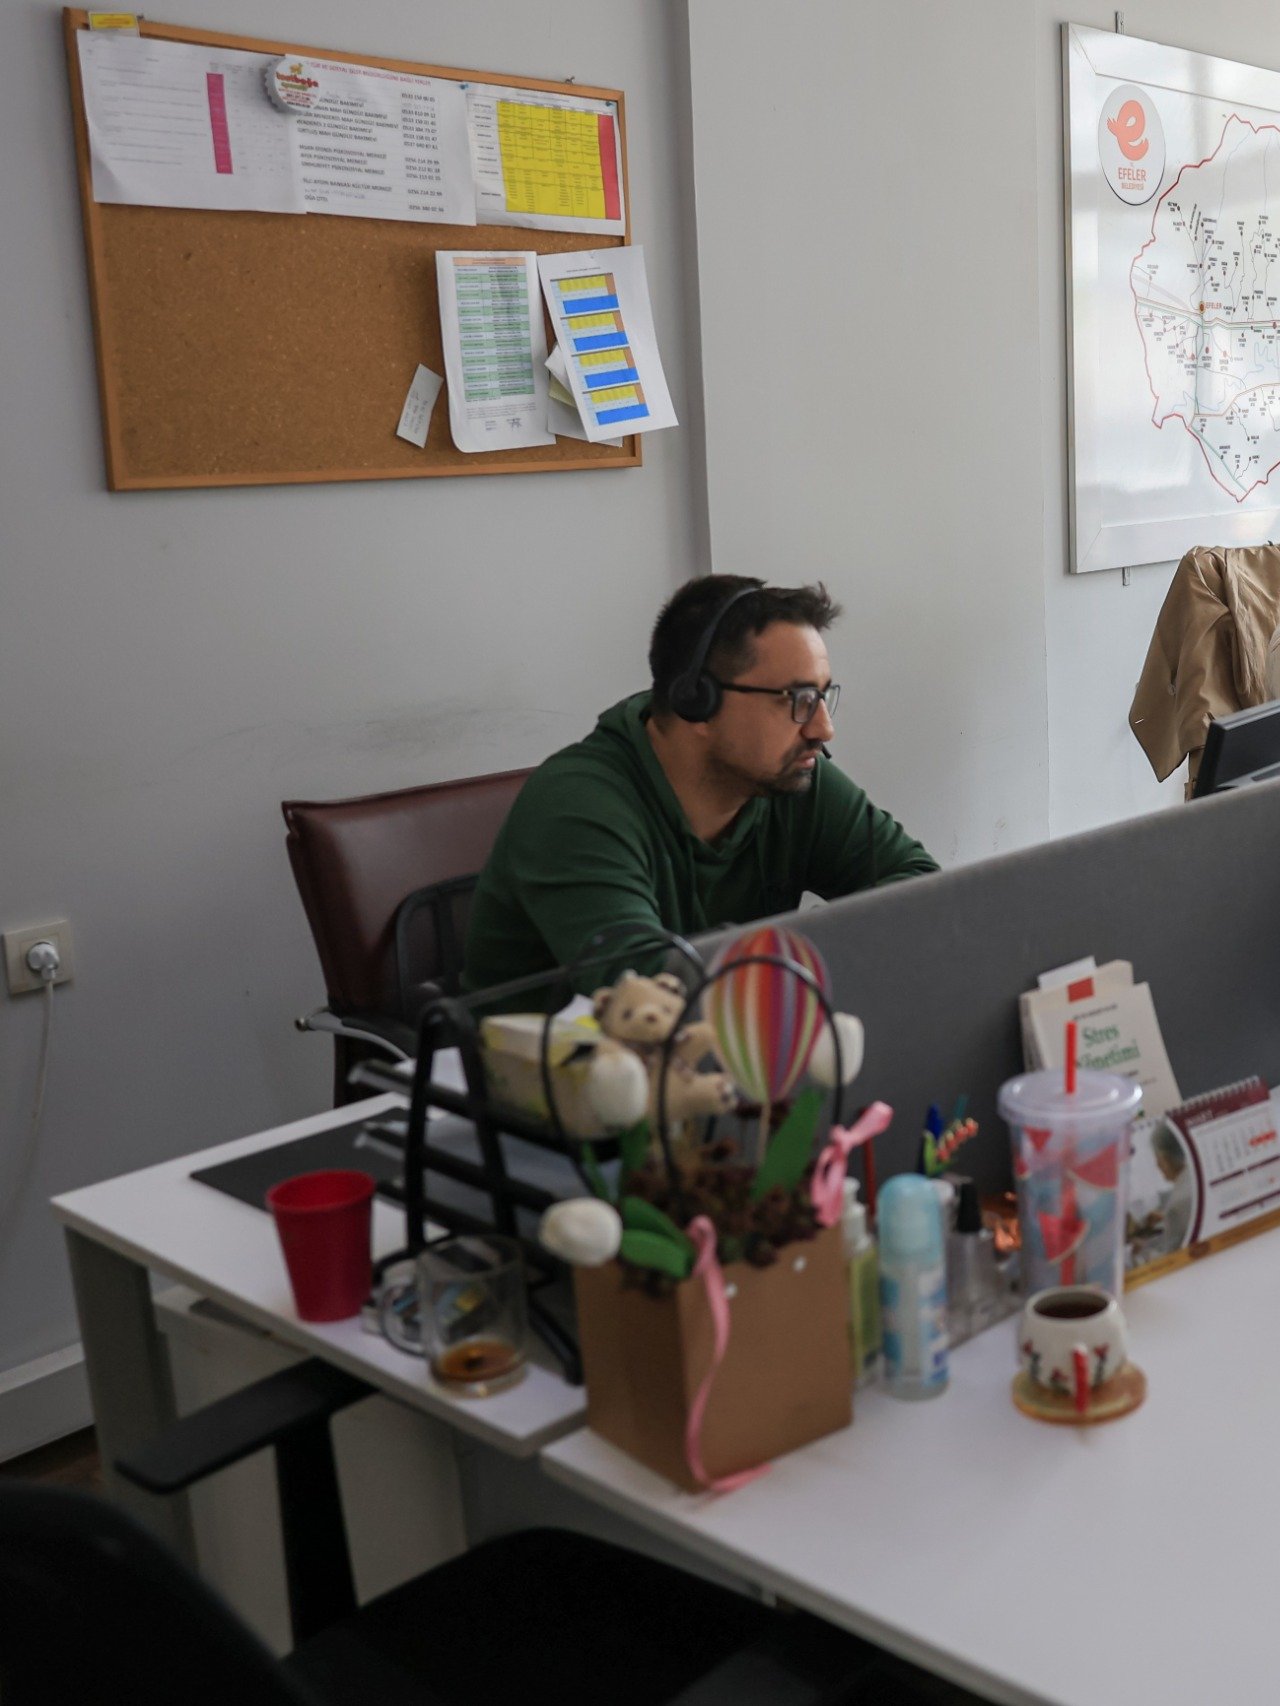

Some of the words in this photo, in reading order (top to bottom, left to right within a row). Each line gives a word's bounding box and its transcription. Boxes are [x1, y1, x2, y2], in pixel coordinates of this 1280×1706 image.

[301, 161, 330, 169] UMHURİYET
[1118, 167, 1147, 181] EFELER
[1205, 302, 1222, 310] EFELER
